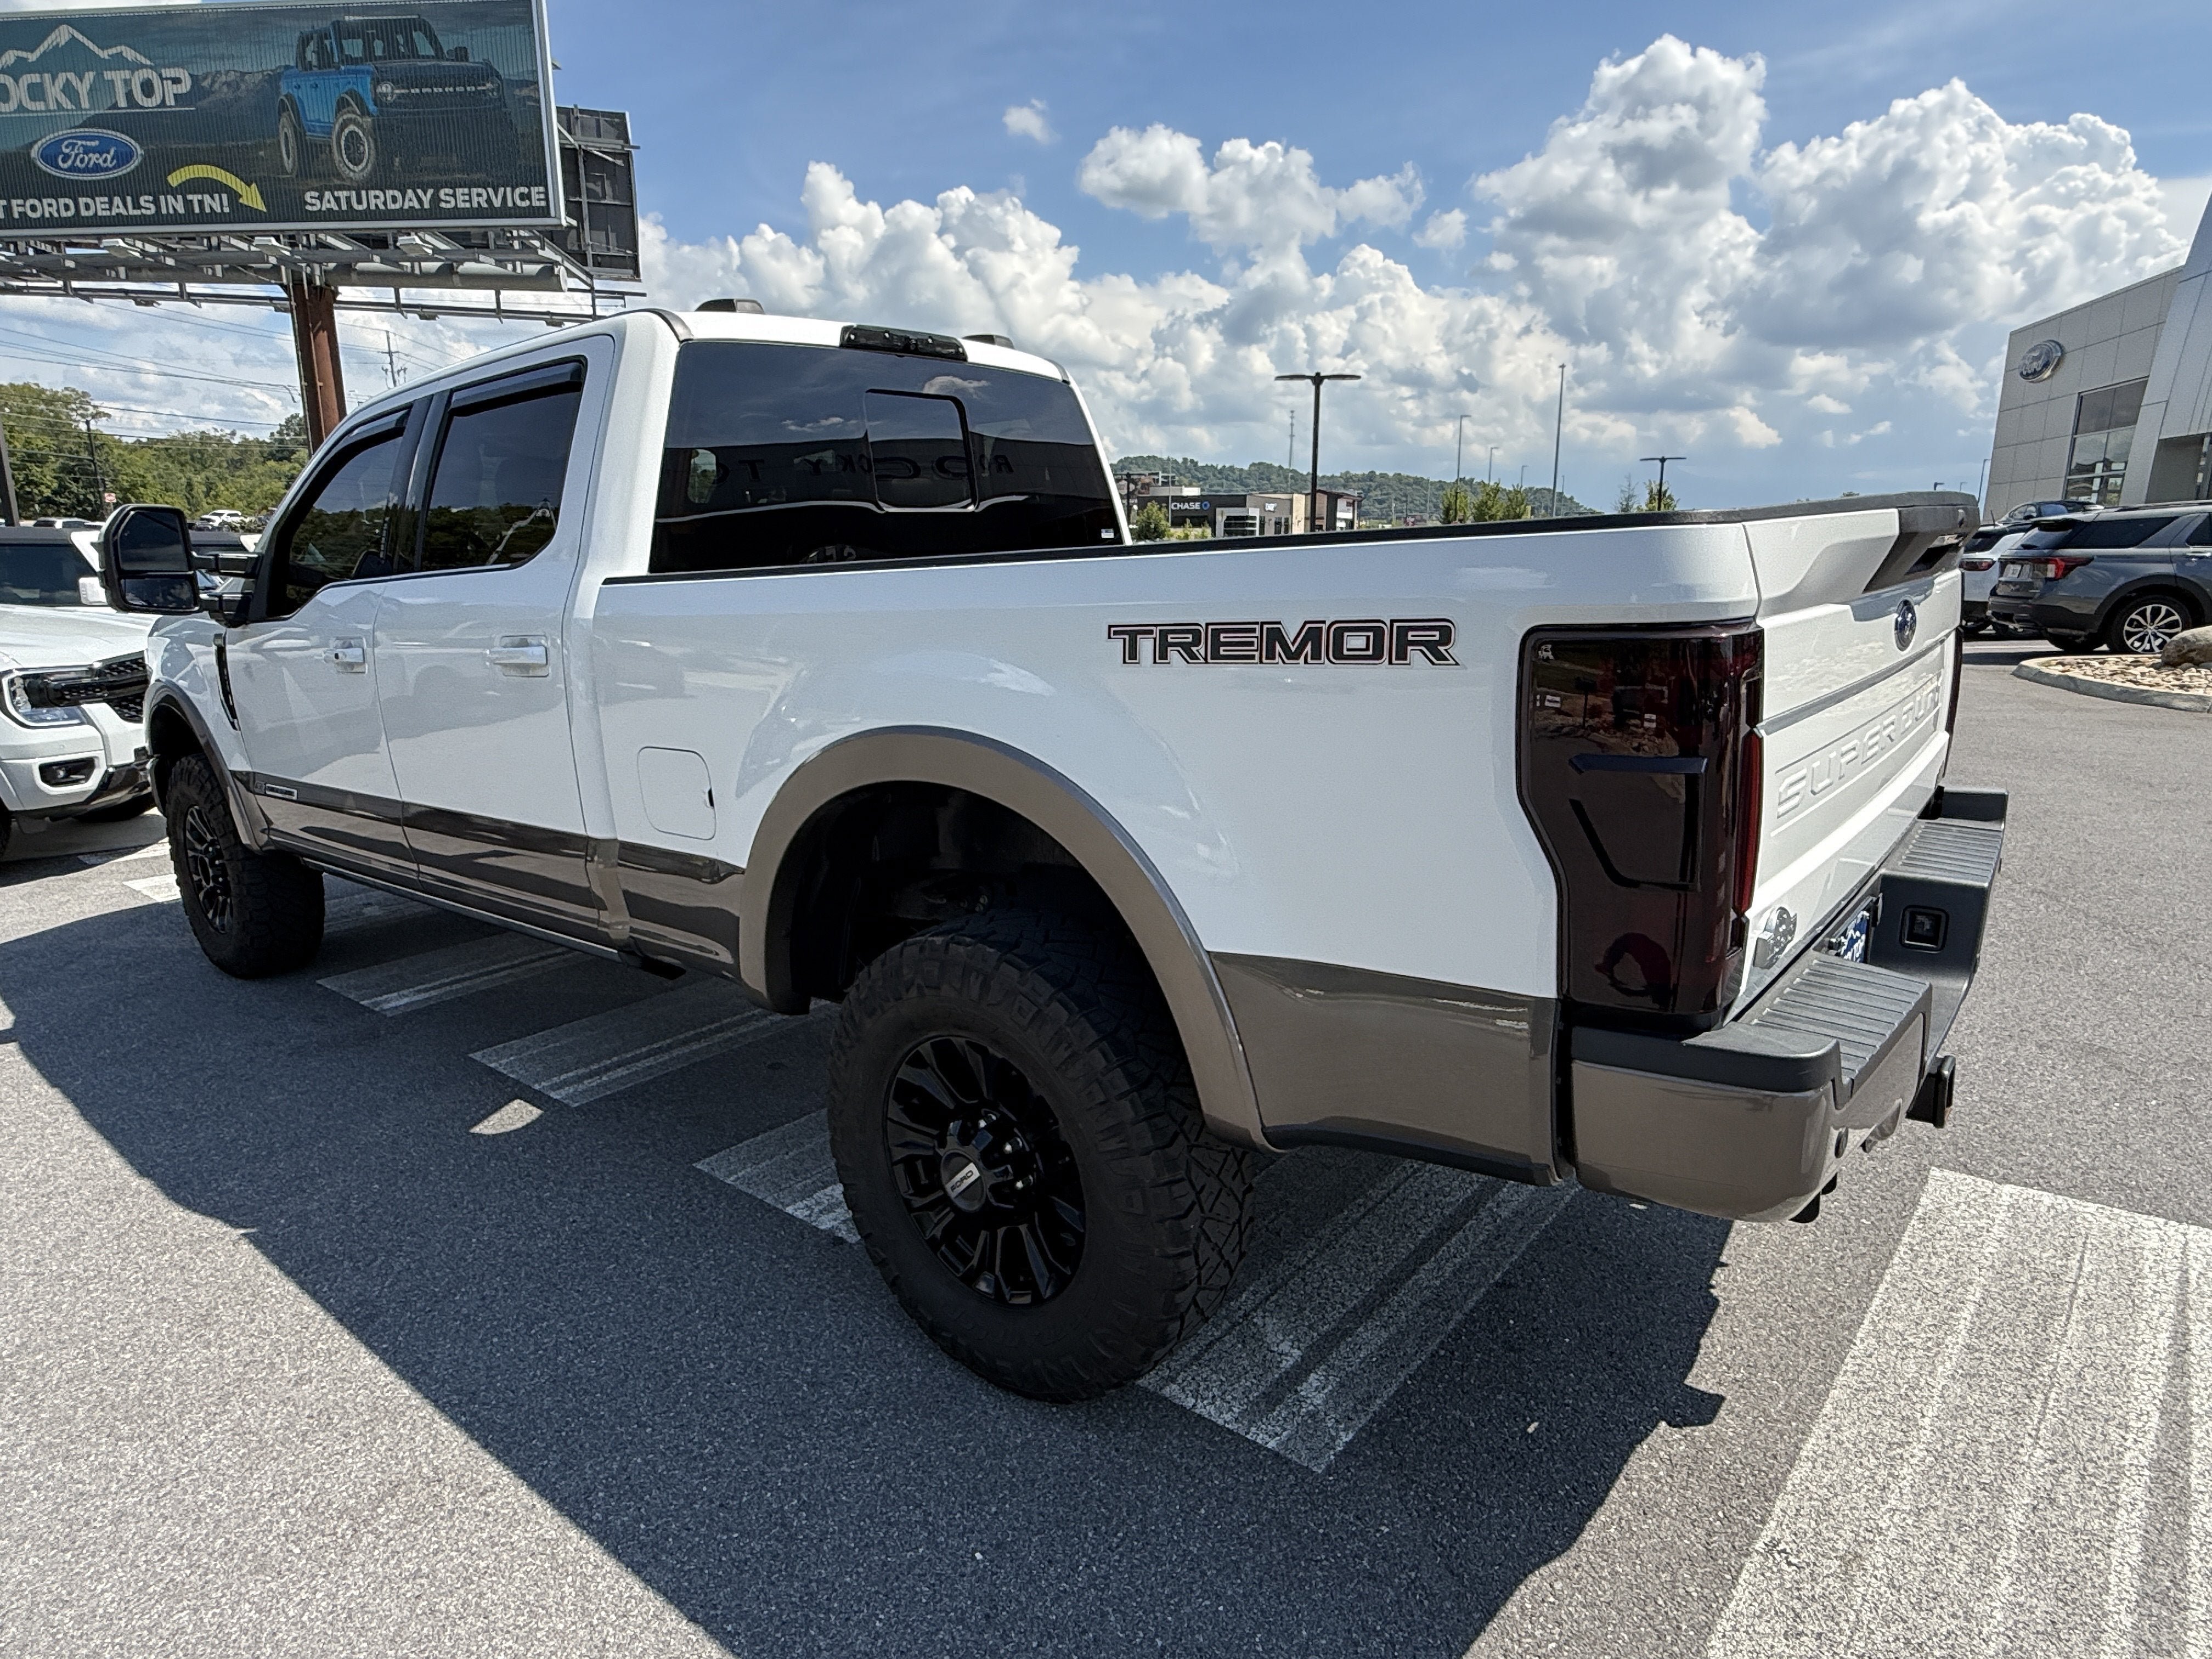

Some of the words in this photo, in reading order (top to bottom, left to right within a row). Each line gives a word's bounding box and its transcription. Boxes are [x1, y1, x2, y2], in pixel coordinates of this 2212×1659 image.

[103, 67, 192, 108] TOP
[58, 139, 116, 168] Ford
[10, 198, 76, 218] FORD
[78, 195, 156, 216] DEALS
[159, 195, 185, 214] IN
[187, 193, 229, 213] TN!
[304, 188, 434, 211] SATURDAY
[439, 186, 547, 208] SERVICE
[1108, 618, 1461, 667] TREMOR
[1777, 715, 1897, 819] SUPER
[950, 1170, 974, 1192] FORD
